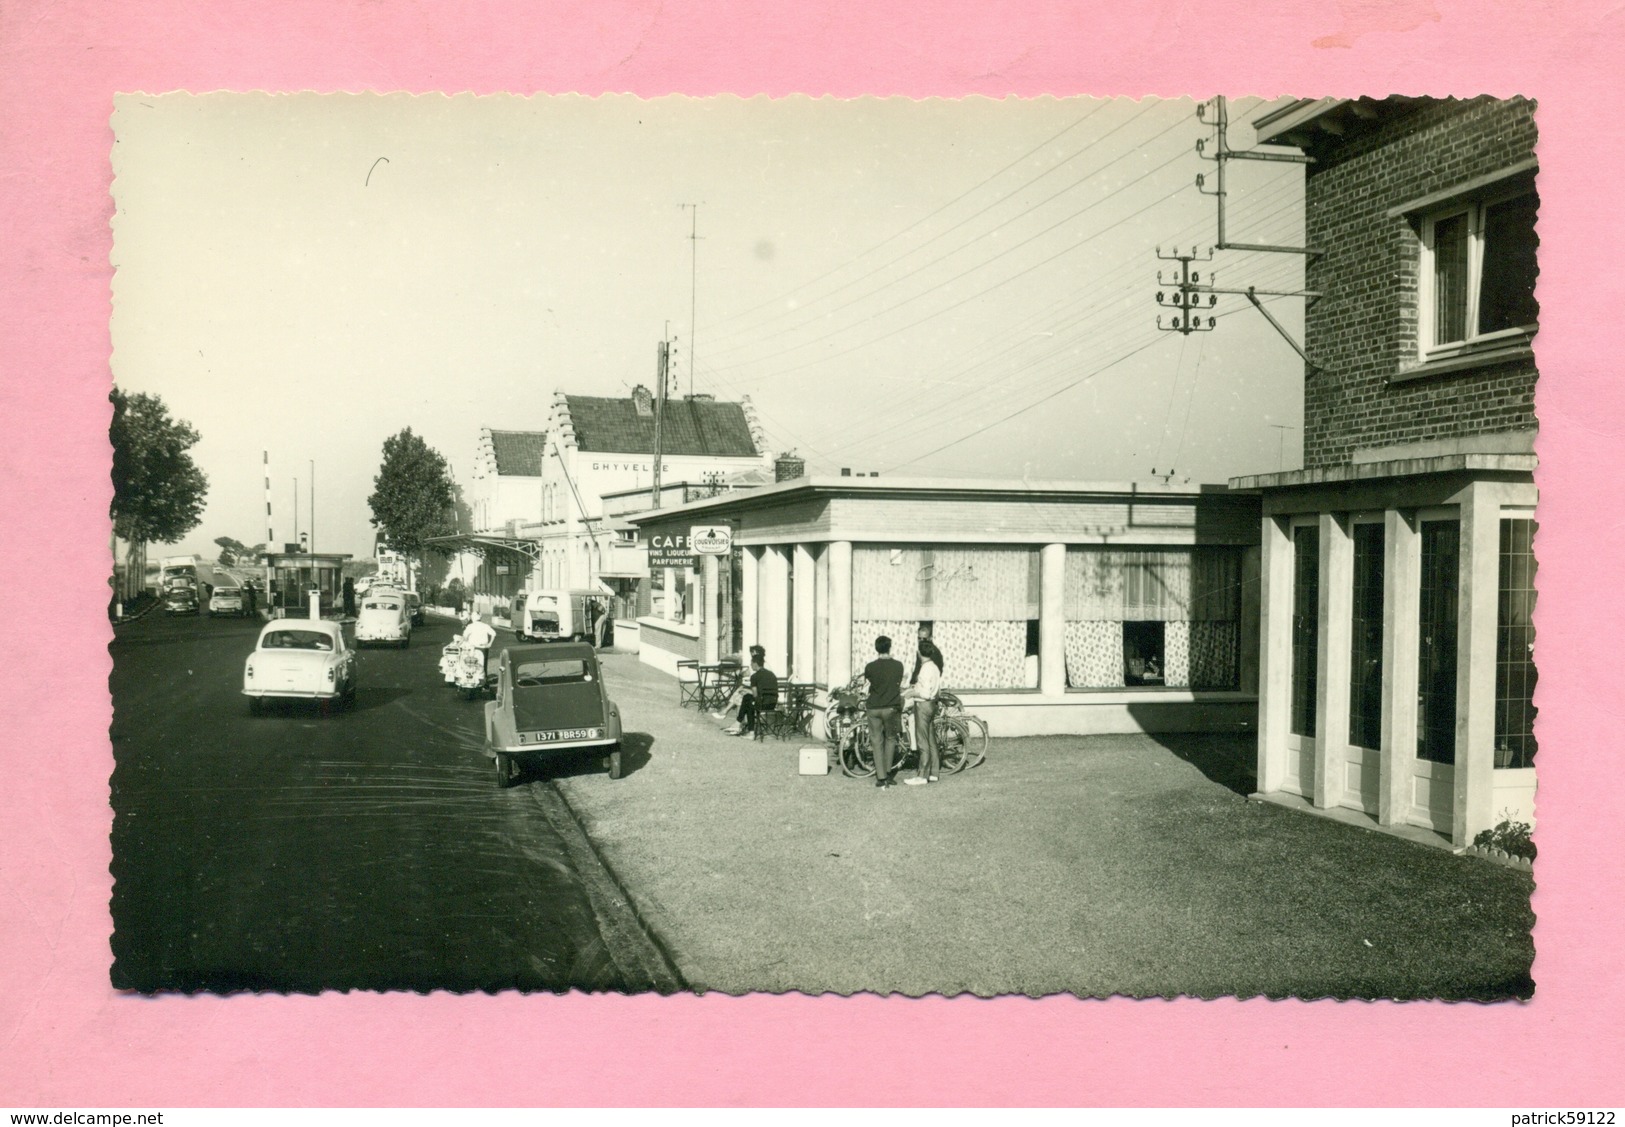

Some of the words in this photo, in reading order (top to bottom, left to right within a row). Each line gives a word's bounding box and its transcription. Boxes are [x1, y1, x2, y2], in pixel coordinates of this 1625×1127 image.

[592, 462, 669, 472] GHYVELE
[649, 549, 663, 557] VINS
[666, 549, 694, 557] LIQUEU
[537, 732, 556, 741] 1371
